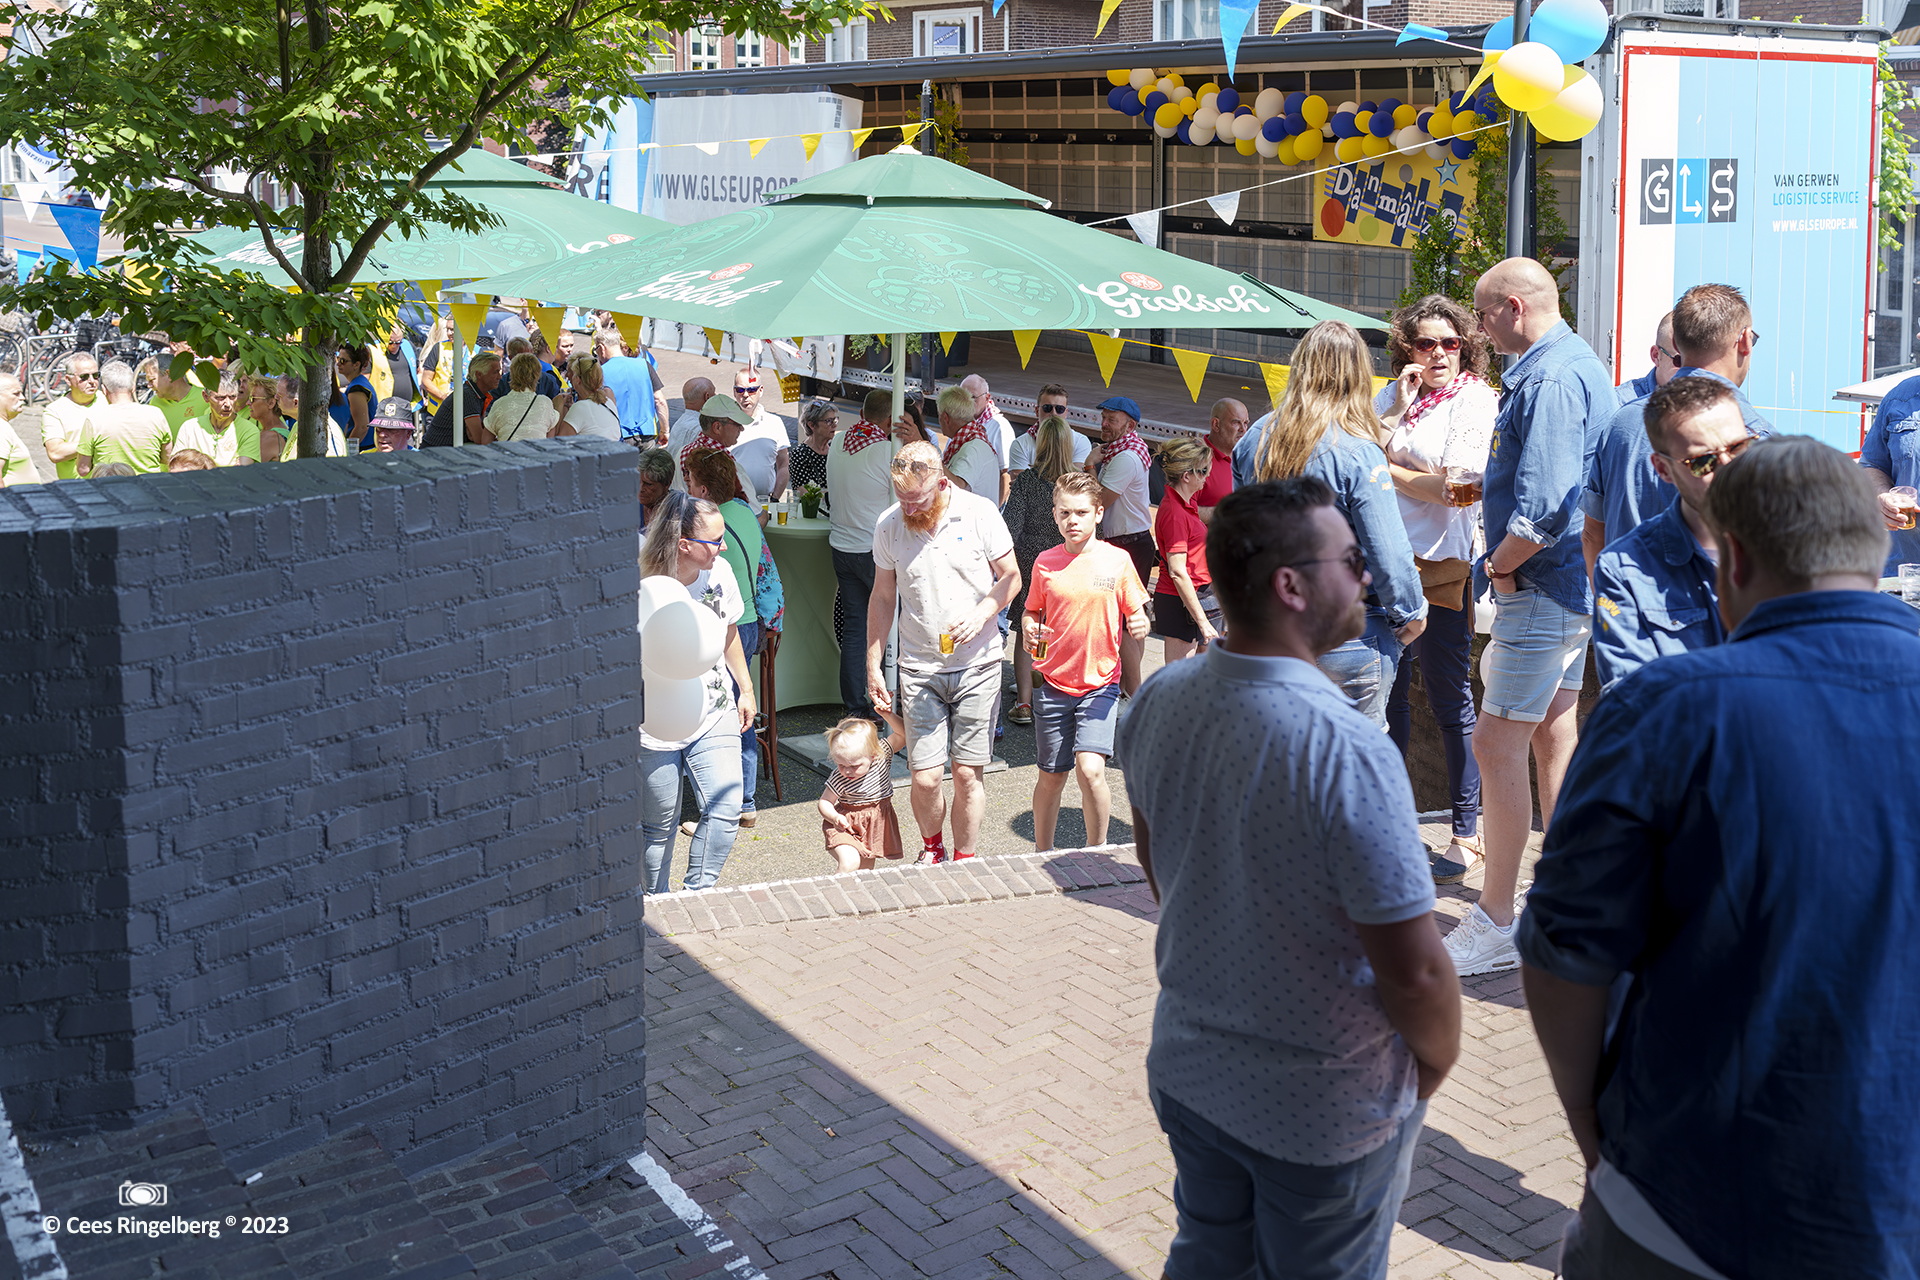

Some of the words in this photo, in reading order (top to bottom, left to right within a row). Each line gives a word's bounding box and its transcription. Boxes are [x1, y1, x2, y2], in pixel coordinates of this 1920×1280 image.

[18, 142, 54, 166] nmarzo.nl
[1774, 174, 1795, 187] VAN
[1797, 173, 1839, 187] GERWEN
[1644, 163, 1735, 218] GLS
[1773, 192, 1817, 206] LOGISTIC
[1820, 191, 1859, 205] SERVICE
[1772, 218, 1858, 232] WWW.GLSEUROPE.NL
[1078, 281, 1270, 318] Grolsch
